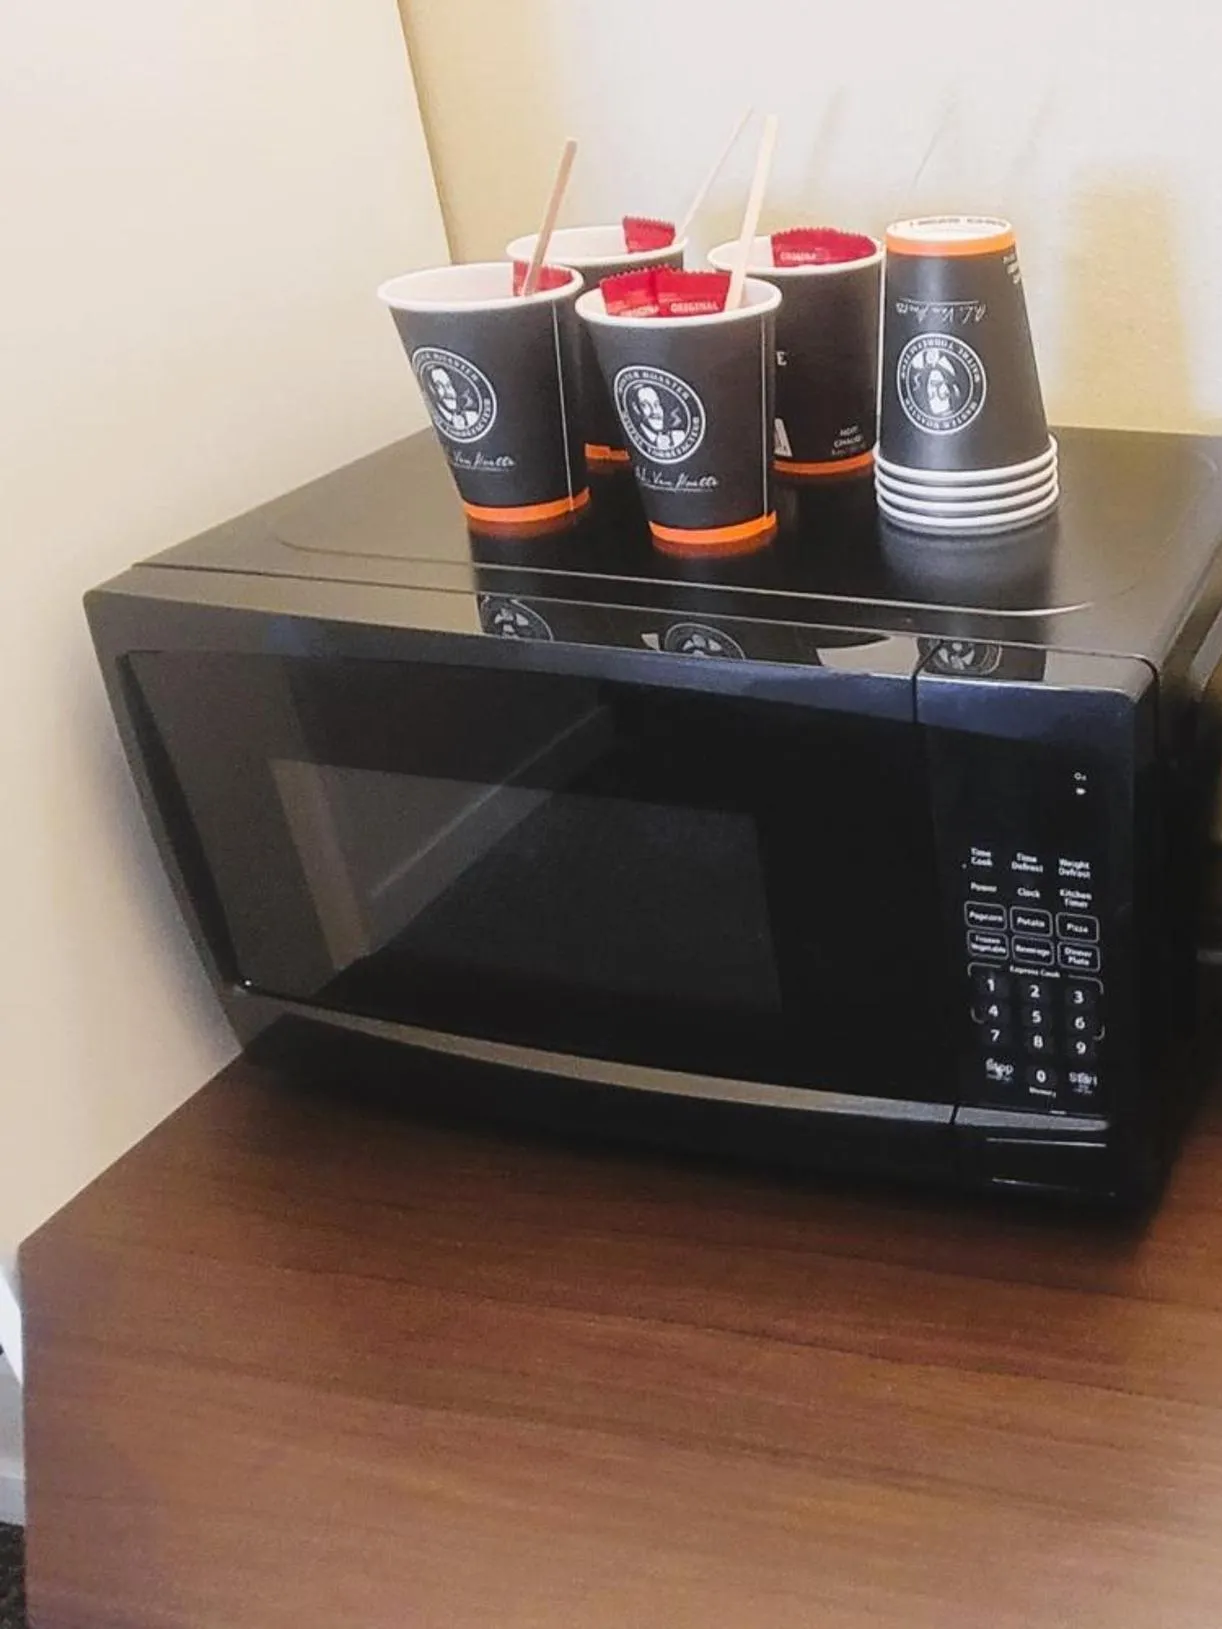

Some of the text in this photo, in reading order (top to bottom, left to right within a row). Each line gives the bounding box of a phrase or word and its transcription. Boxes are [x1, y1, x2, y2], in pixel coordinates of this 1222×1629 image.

[1011, 861, 1043, 873] Defrost
[1059, 868, 1090, 879] Defrost
[1017, 887, 1041, 899] Clock
[1060, 889, 1092, 900] Kitchen
[969, 910, 1003, 922] Popcorn
[1067, 923, 1088, 933] Pizza
[1041, 969, 1060, 978] Cook
[987, 978, 995, 992] 1
[1030, 984, 1040, 998] 2
[1074, 990, 1084, 1004] 3
[988, 1005, 998, 1018] 4
[1032, 1010, 1042, 1024] 5
[1075, 1016, 1085, 1030] 6
[990, 1029, 1000, 1042] 7
[1033, 1035, 1043, 1049] 8
[1076, 1041, 1086, 1055] 9
[1036, 1069, 1046, 1083] 0
